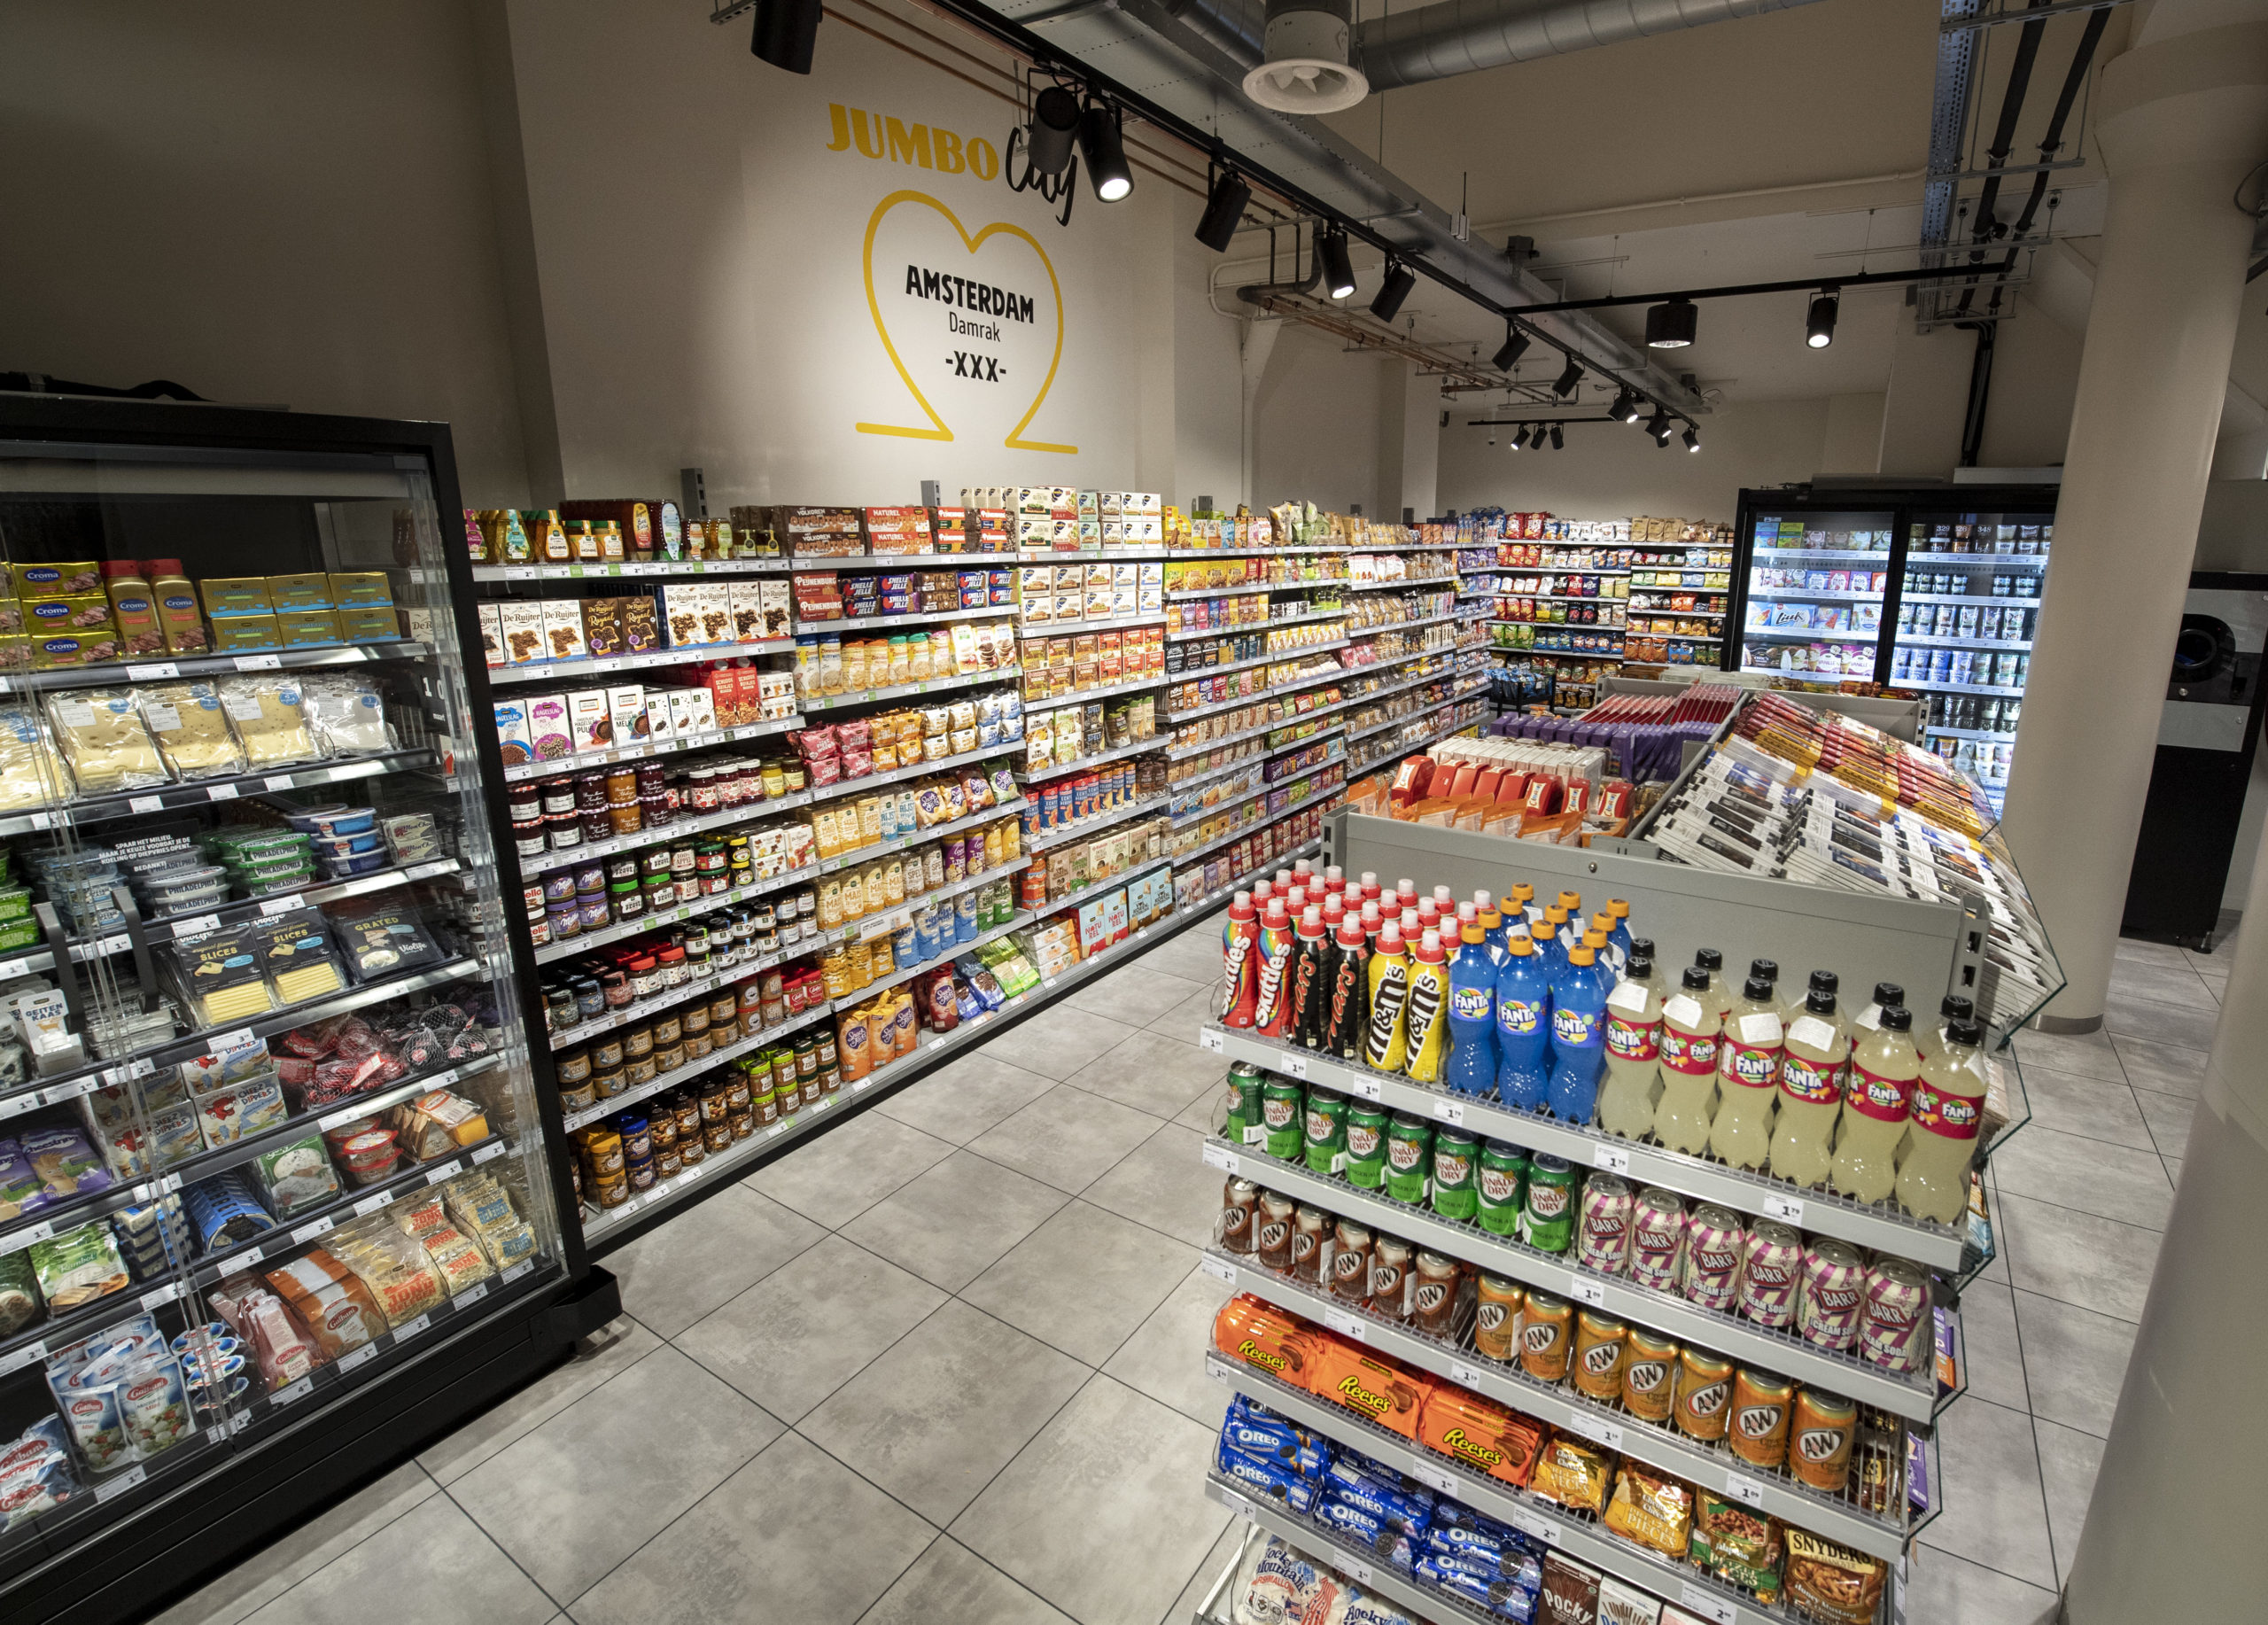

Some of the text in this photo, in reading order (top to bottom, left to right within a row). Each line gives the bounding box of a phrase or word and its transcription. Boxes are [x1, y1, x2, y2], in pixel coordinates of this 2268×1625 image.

[827, 103, 998, 181] JUMBO
[905, 264, 1034, 323] AMSTERDAM
[949, 312, 1000, 342] Damrak
[503, 613, 540, 624] De Ruijter
[555, 610, 579, 619] Ruijter
[535, 707, 560, 717] HAGELSLAG
[99, 850, 119, 859] MAAK
[127, 844, 146, 853] KEUZE
[147, 840, 175, 850] VOORDAT
[115, 840, 136, 850] SPAAR
[136, 838, 149, 847] HET
[252, 845, 299, 859] PHILADELPHIA
[101, 854, 128, 865] KOELING
[137, 847, 170, 858] DIEPVRIES
[257, 861, 301, 875] PHILADELPHIA
[168, 879, 215, 895] PHILADELPHIA
[268, 875, 309, 890] PHILADELPHIA
[172, 896, 219, 911] PHILADELPHIA
[355, 916, 399, 931] GRATED
[274, 929, 308, 943] SLICES
[200, 946, 237, 961] SLICES
[399, 942, 428, 953] Violife
[1223, 936, 1251, 1016] Skittles
[1255, 943, 1291, 1028] Skittles
[1455, 992, 1488, 1009] FANTA
[26, 1002, 64, 1017] GEITEN
[32, 1010, 61, 1022] KAAS
[1501, 1006, 1536, 1022] FANTA
[1554, 1013, 1588, 1033] FANTA
[1607, 1025, 1641, 1046] FANTA
[1690, 1044, 1716, 1057] FANTA
[1736, 1054, 1775, 1074] FANTA
[1783, 1061, 1822, 1088] FANTA
[238, 1083, 263, 1099] CHEEZ
[242, 1089, 273, 1105] DIPPERS
[1868, 1085, 1900, 1101] FANTA
[1264, 1105, 1294, 1116] ANADA
[1942, 1101, 1976, 1119] FANTA
[155, 1118, 189, 1135] DIPPERS
[1270, 1115, 1286, 1124] DRY
[1307, 1119, 1335, 1129] ANADA
[1309, 1127, 1325, 1136] DRY
[1348, 1131, 1380, 1142] ANADA
[1389, 1145, 1423, 1155] ANADA
[1394, 1155, 1412, 1163] DRY
[1436, 1161, 1471, 1170] ANADA
[1441, 1170, 1460, 1179] DRY
[1482, 1176, 1518, 1186] ANADA
[1488, 1186, 1507, 1195] DRY
[1532, 1191, 1569, 1202] ANADA
[1538, 1201, 1558, 1211] DRY
[1591, 1217, 1622, 1232] BARR
[1638, 1232, 1672, 1249] BARR
[1584, 1246, 1605, 1260] CREAM
[1700, 1252, 1736, 1268] BARR
[60, 1256, 96, 1272] Rambol
[1632, 1259, 1674, 1278] CREAM SODA
[1751, 1264, 1785, 1282] BARR
[388, 1277, 434, 1309] JONG
[1821, 1289, 1859, 1307] BARR
[1744, 1291, 1788, 1315] CREAM SODA
[329, 1309, 356, 1328] Galbani
[1868, 1301, 1905, 1324] BARR
[1861, 1330, 1907, 1358] CREAM SODA
[277, 1346, 306, 1364] Galbani
[1238, 1340, 1286, 1372] Reese's
[130, 1379, 167, 1398] Galbani
[1337, 1375, 1392, 1413] Reese's
[74, 1402, 102, 1415] Galbani
[1239, 1430, 1280, 1446] OREO
[1443, 1427, 1504, 1466] Reese's
[1232, 1465, 1271, 1485] OREO
[1340, 1490, 1383, 1515] OREO
[1332, 1504, 1378, 1529] OREO
[1449, 1528, 1500, 1550] OREO
[1627, 1513, 1677, 1549] PIECES
[1266, 1547, 1292, 1568] ocky
[1437, 1556, 1488, 1577] OREO
[1257, 1559, 1307, 1593] Mountain
[1344, 1605, 1386, 1625] Rocky
